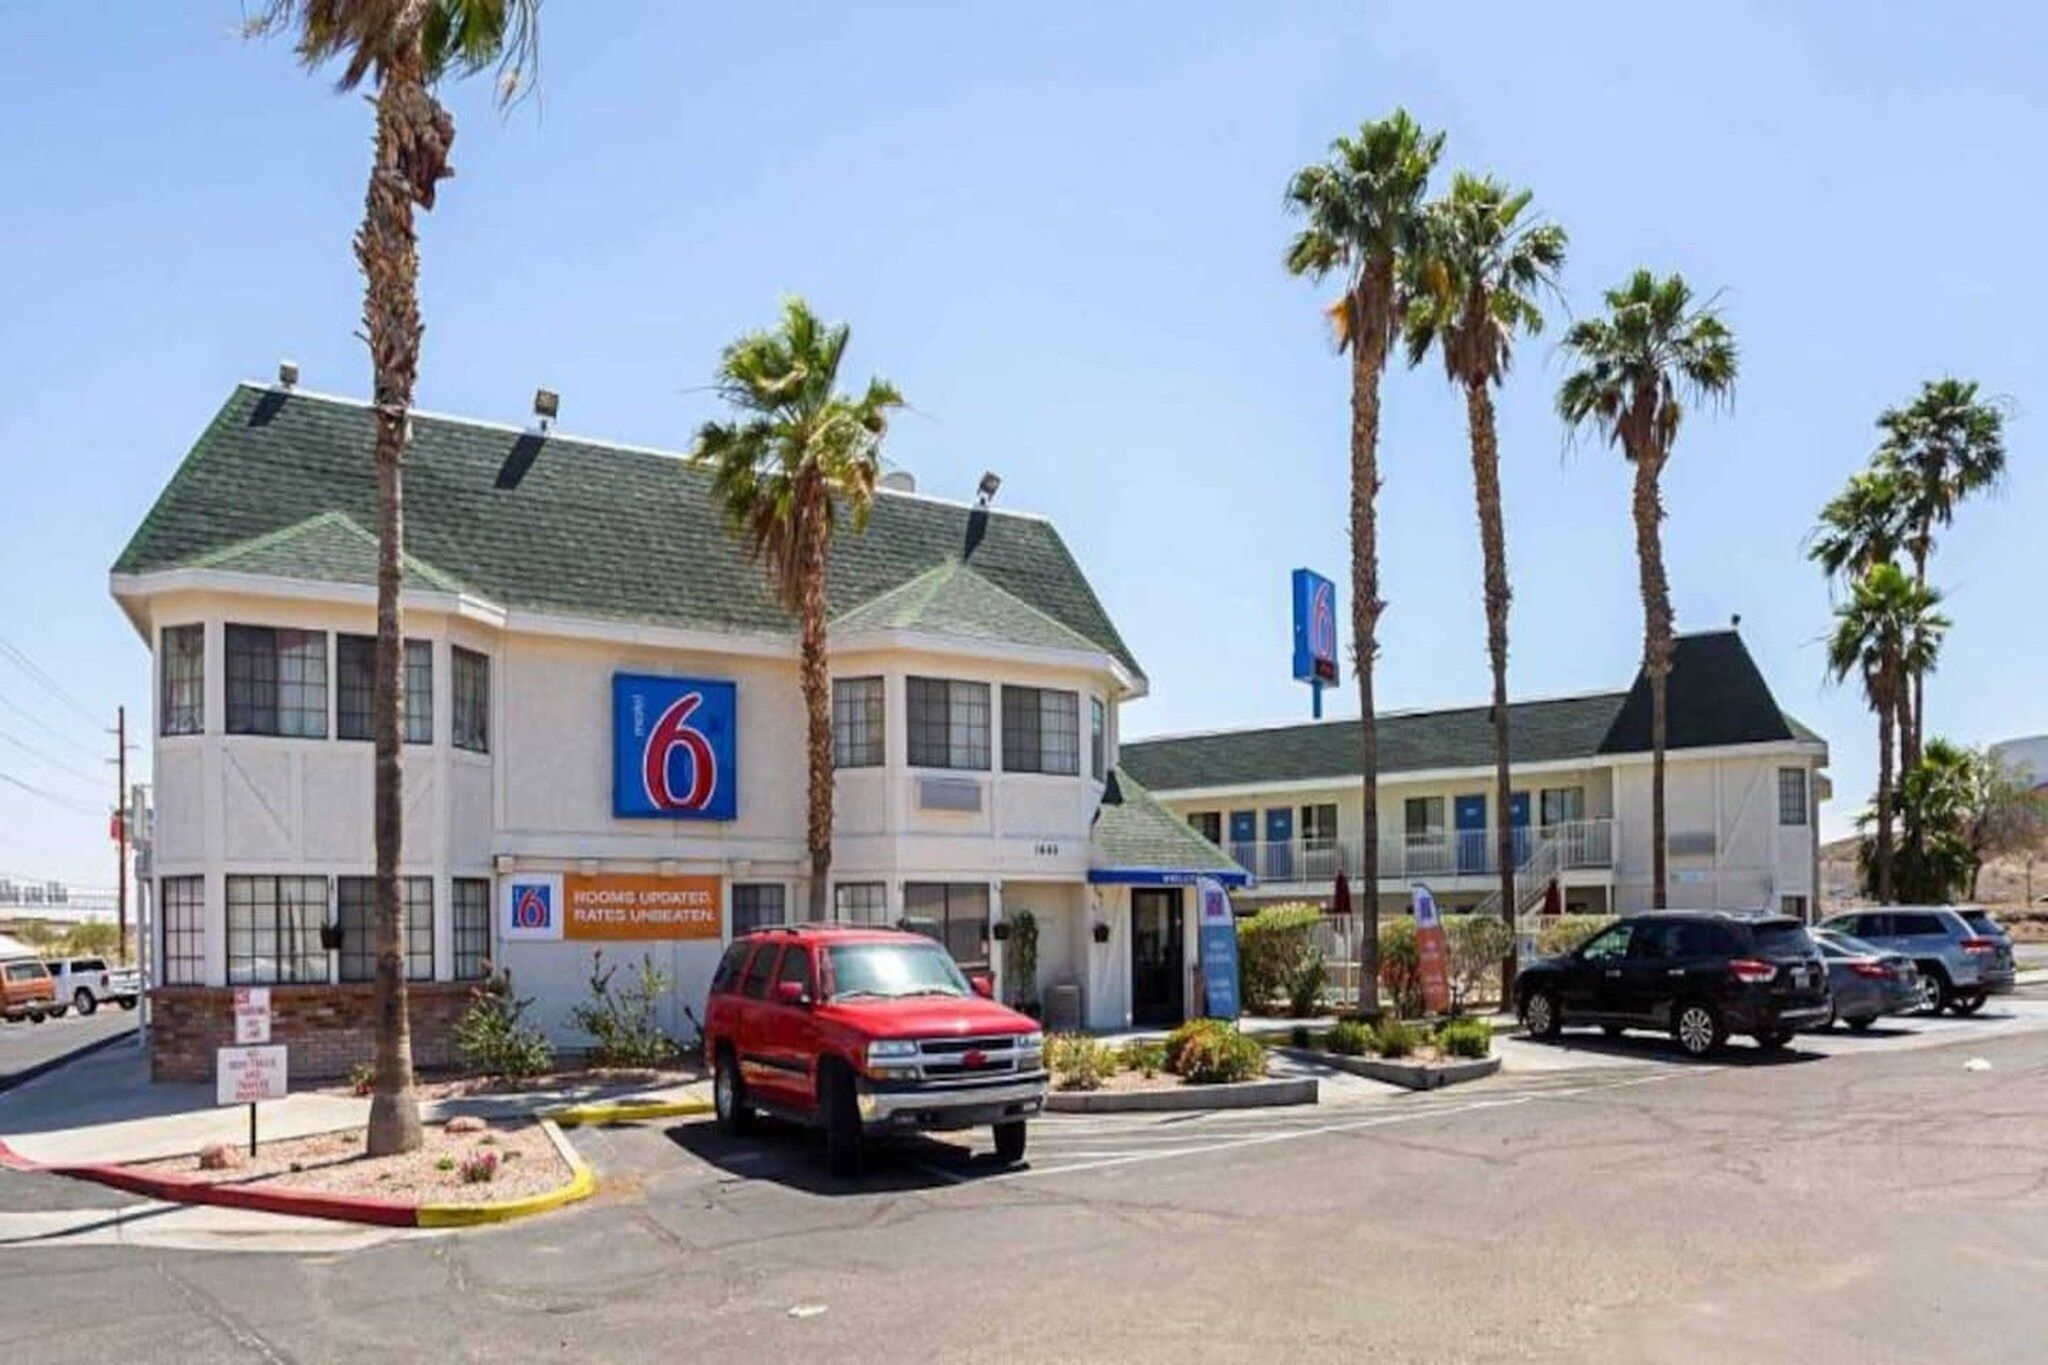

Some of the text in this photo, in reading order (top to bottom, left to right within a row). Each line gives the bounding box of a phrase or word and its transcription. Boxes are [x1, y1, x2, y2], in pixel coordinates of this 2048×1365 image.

[1312, 582, 1332, 659] 6
[643, 691, 717, 809] 6
[518, 889, 546, 928] 6
[573, 908, 627, 922] RATES
[574, 891, 634, 904] ROOMS
